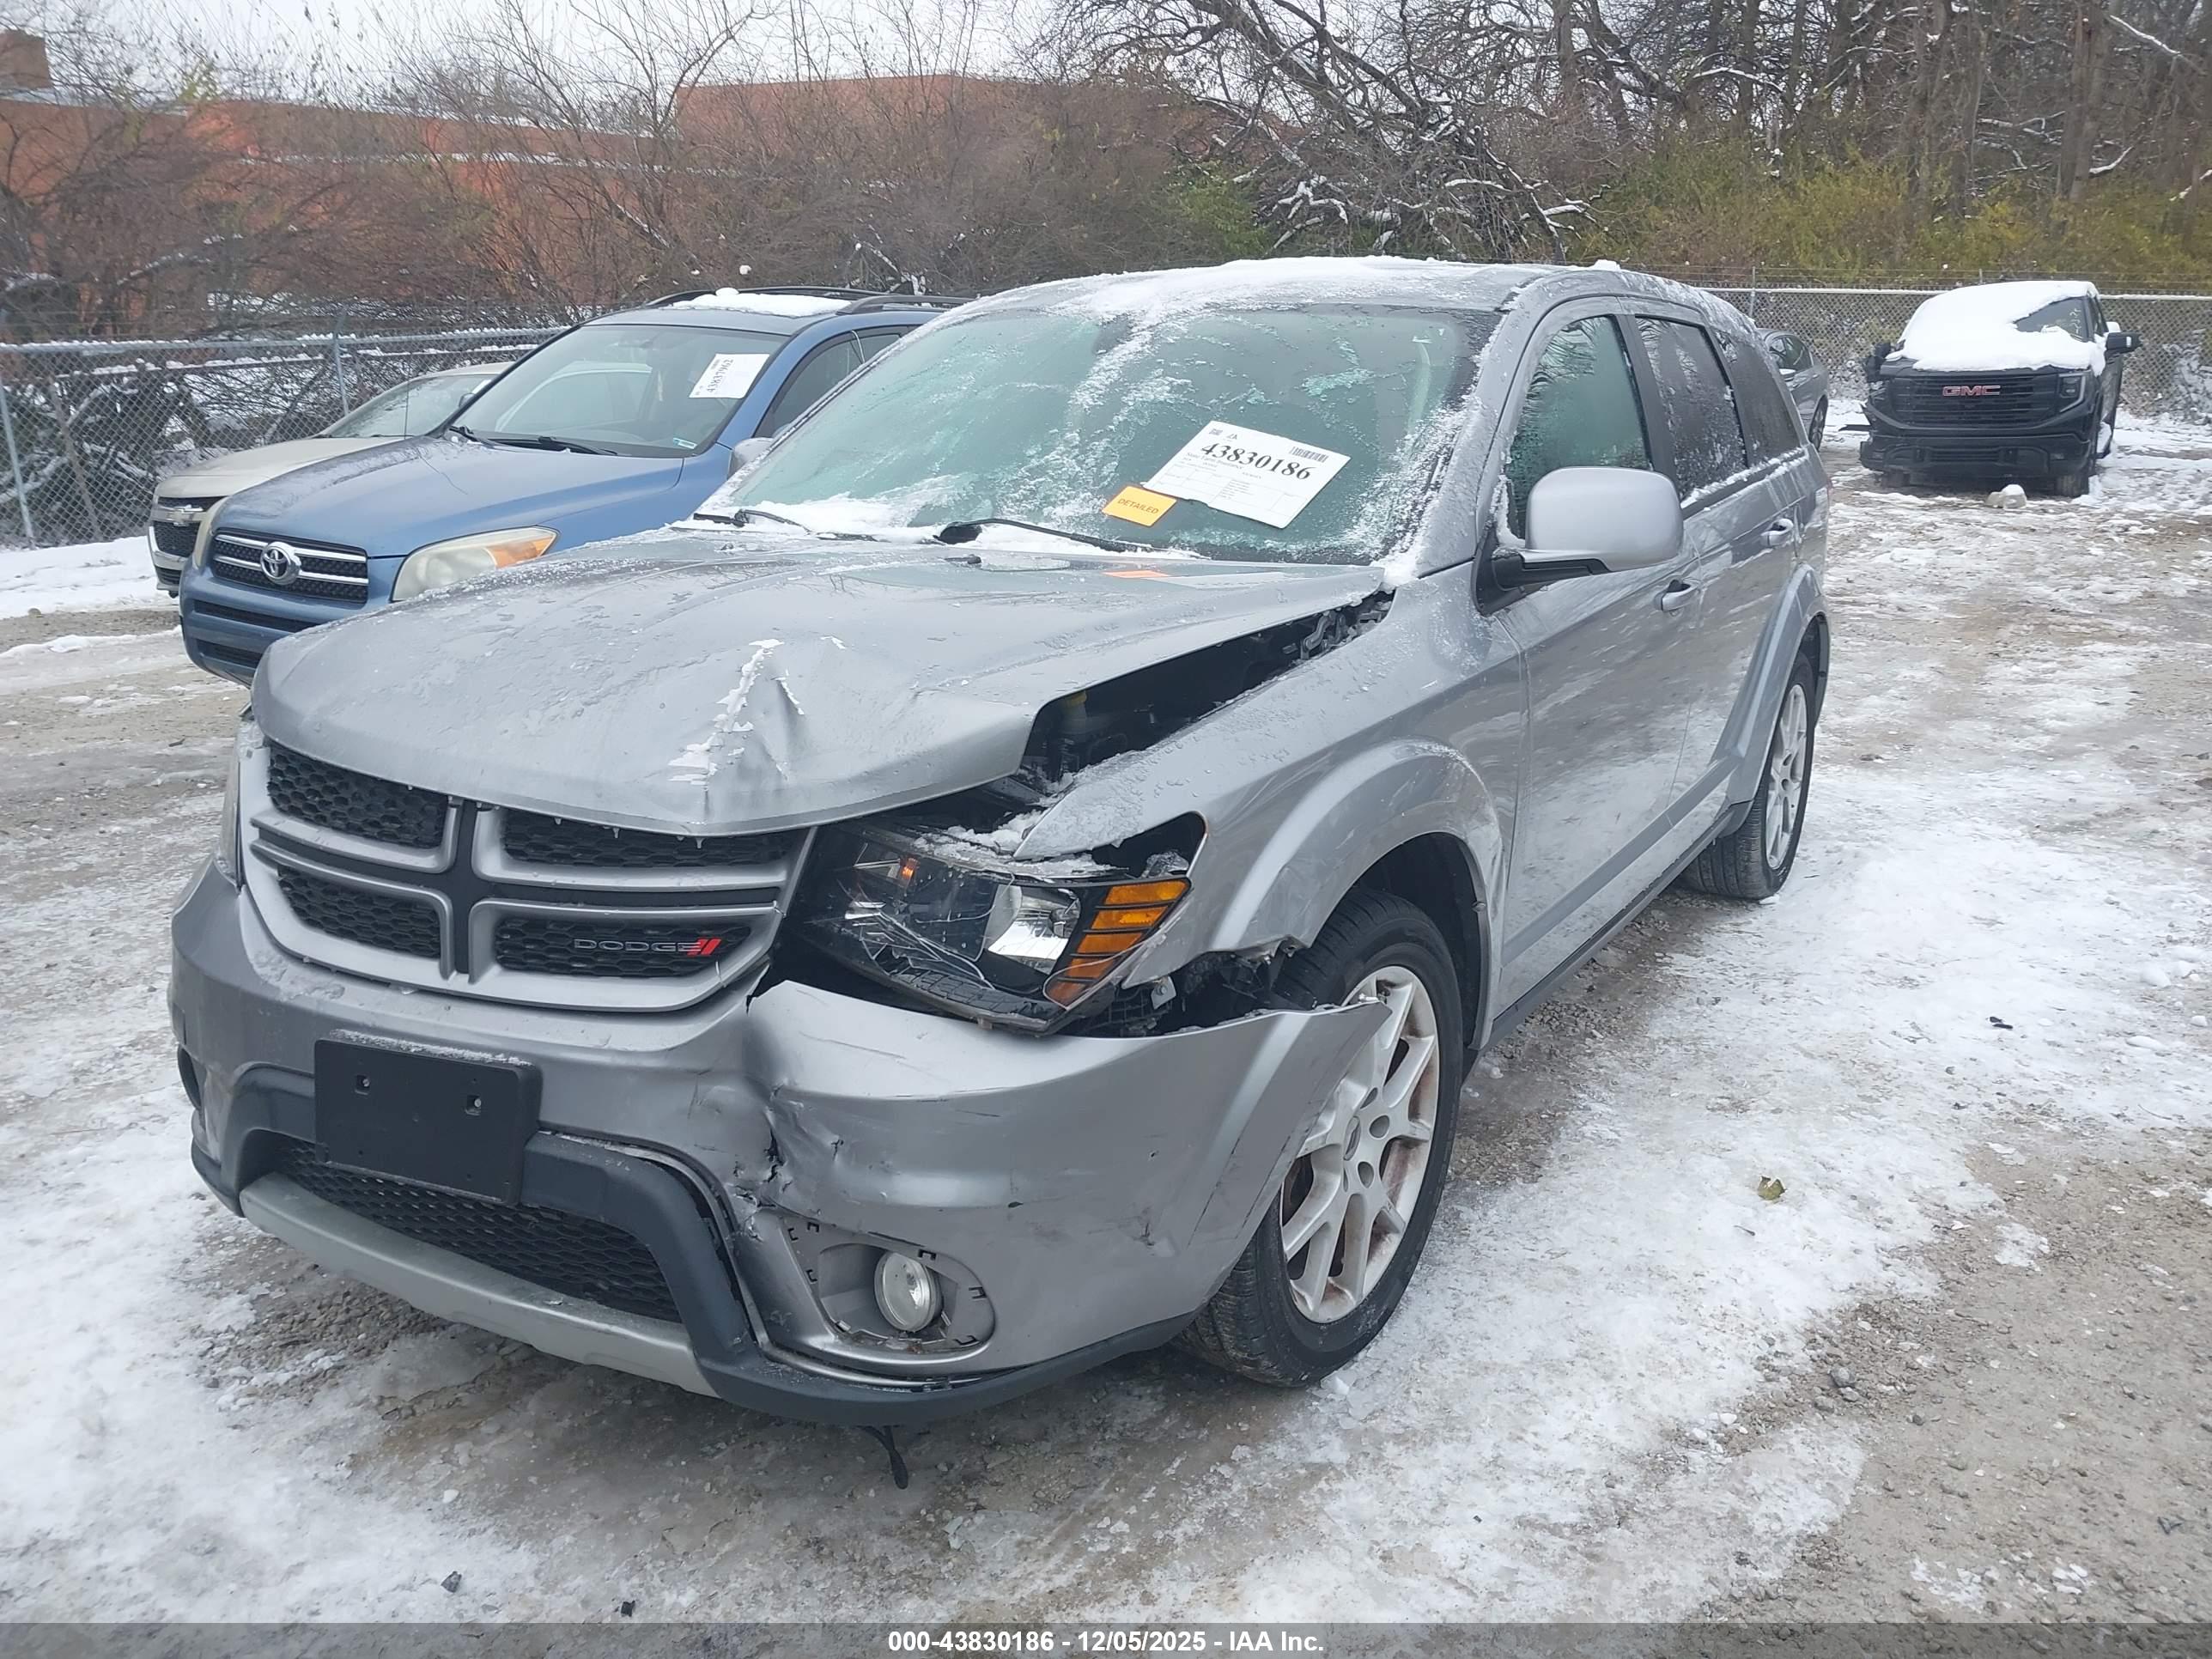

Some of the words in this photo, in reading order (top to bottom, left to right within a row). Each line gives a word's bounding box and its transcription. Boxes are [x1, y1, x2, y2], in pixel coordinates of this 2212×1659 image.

[1942, 385, 2001, 397] GMC
[1200, 442, 1317, 480] 43830186
[1117, 497, 1160, 515] DETAILED
[574, 939, 702, 952] DODGE
